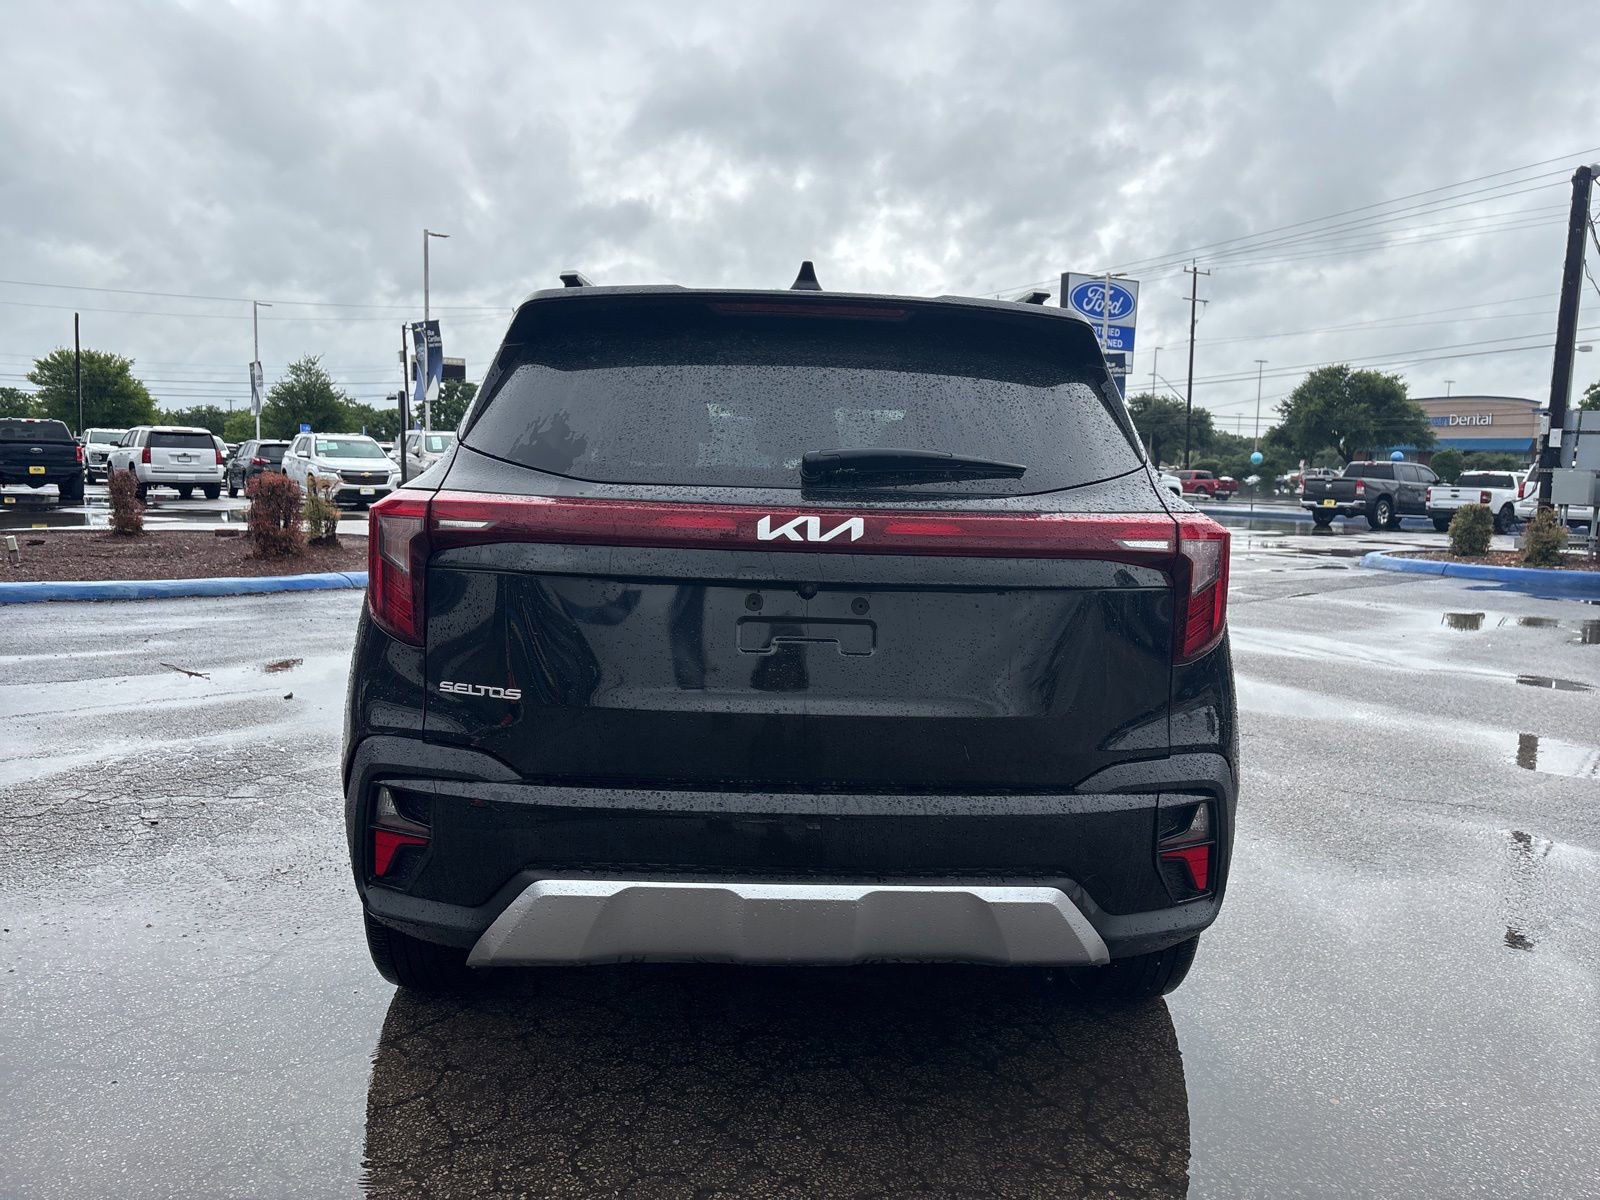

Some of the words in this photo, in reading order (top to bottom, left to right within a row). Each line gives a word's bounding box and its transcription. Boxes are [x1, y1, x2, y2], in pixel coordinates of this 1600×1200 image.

[1083, 286, 1124, 314] Ford
[1449, 413, 1493, 426] Dental
[757, 515, 864, 541] KIA
[439, 681, 522, 700] SELTOS
